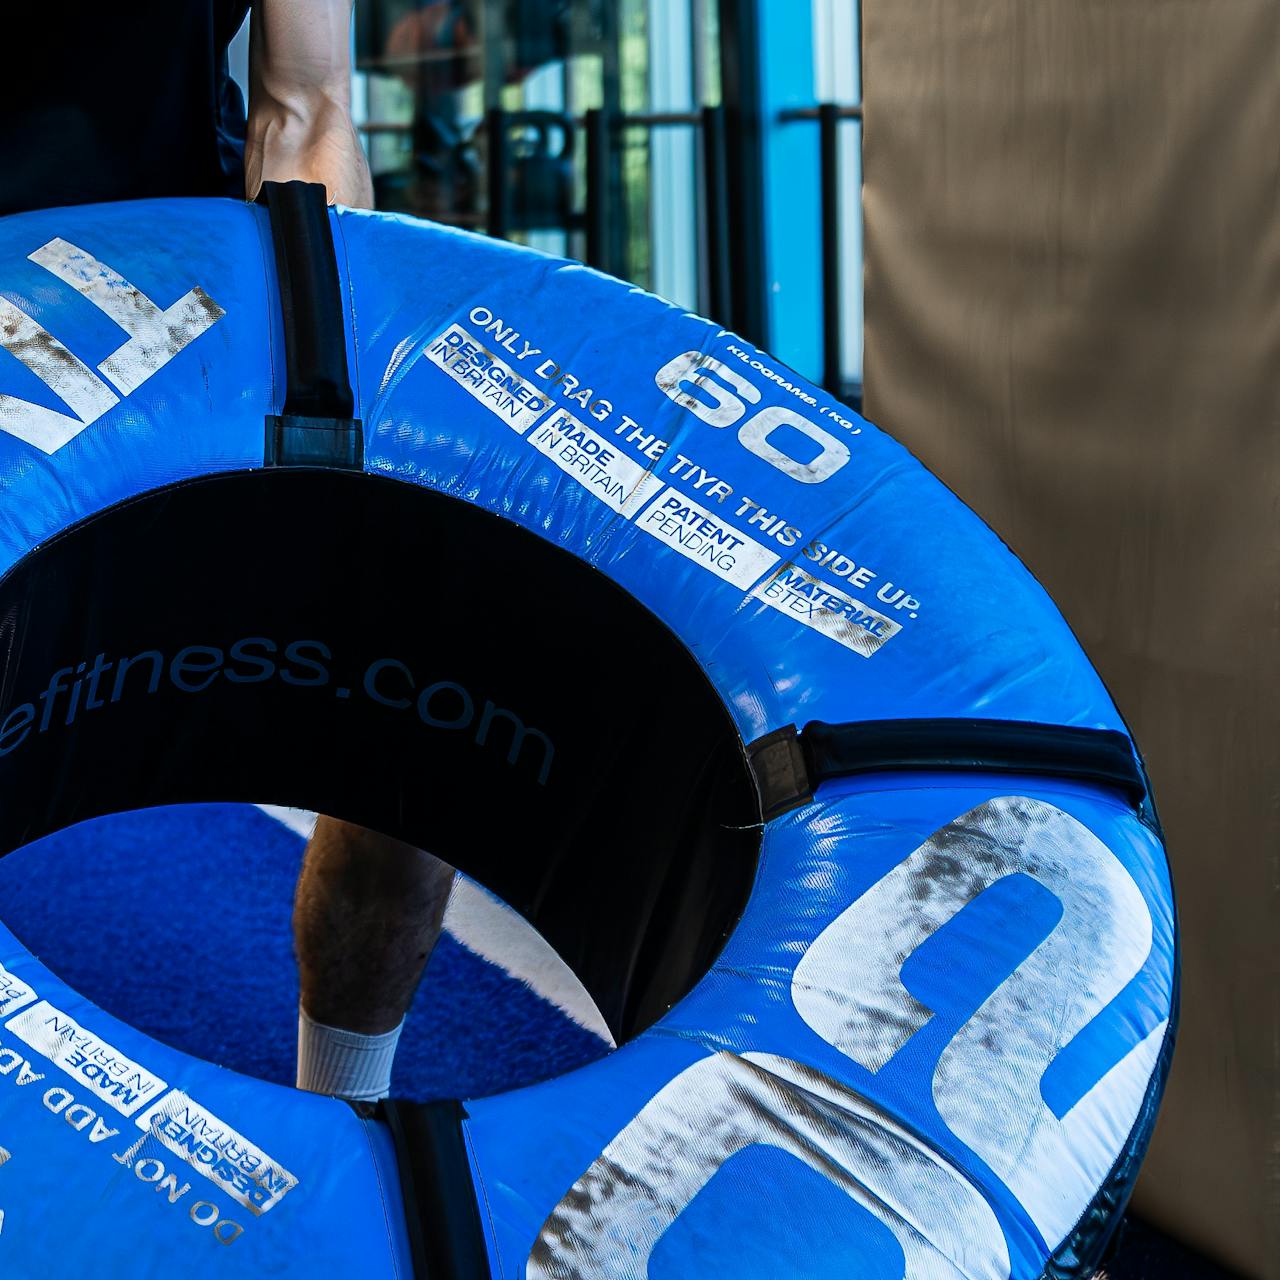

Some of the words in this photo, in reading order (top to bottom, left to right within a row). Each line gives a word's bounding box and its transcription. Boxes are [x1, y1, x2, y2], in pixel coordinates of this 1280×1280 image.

[432, 343, 454, 363] IN
[452, 358, 522, 418] BRITAIN
[445, 331, 544, 412] DESIGNED
[552, 416, 615, 467] MADE
[655, 350, 850, 484] 60
[470, 307, 541, 360] ONLY
[535, 360, 612, 421] DRAG
[615, 416, 669, 460] THE
[669, 454, 734, 503] TIYR
[735, 496, 802, 547] THIS
[804, 541, 877, 589] SIDE
[876, 583, 920, 619] UP.
[538, 428, 562, 449] IN
[559, 445, 629, 505] BRITAIN
[647, 510, 736, 572] PENDING
[662, 498, 744, 551] PATENT
[764, 582, 821, 619] BTEX
[780, 570, 890, 637] MATERIAL
[45, 1016, 129, 1076] BRITAIN
[65, 1049, 138, 1106] MADE
[127, 1073, 155, 1095] IN
[43, 1087, 120, 1143] ADD
[183, 1107, 261, 1171] BRITAIN
[112, 1131, 191, 1203] NOT
[150, 1113, 271, 1208] DESIGNED
[261, 1166, 290, 1193] IN
[190, 1200, 244, 1246] DO
